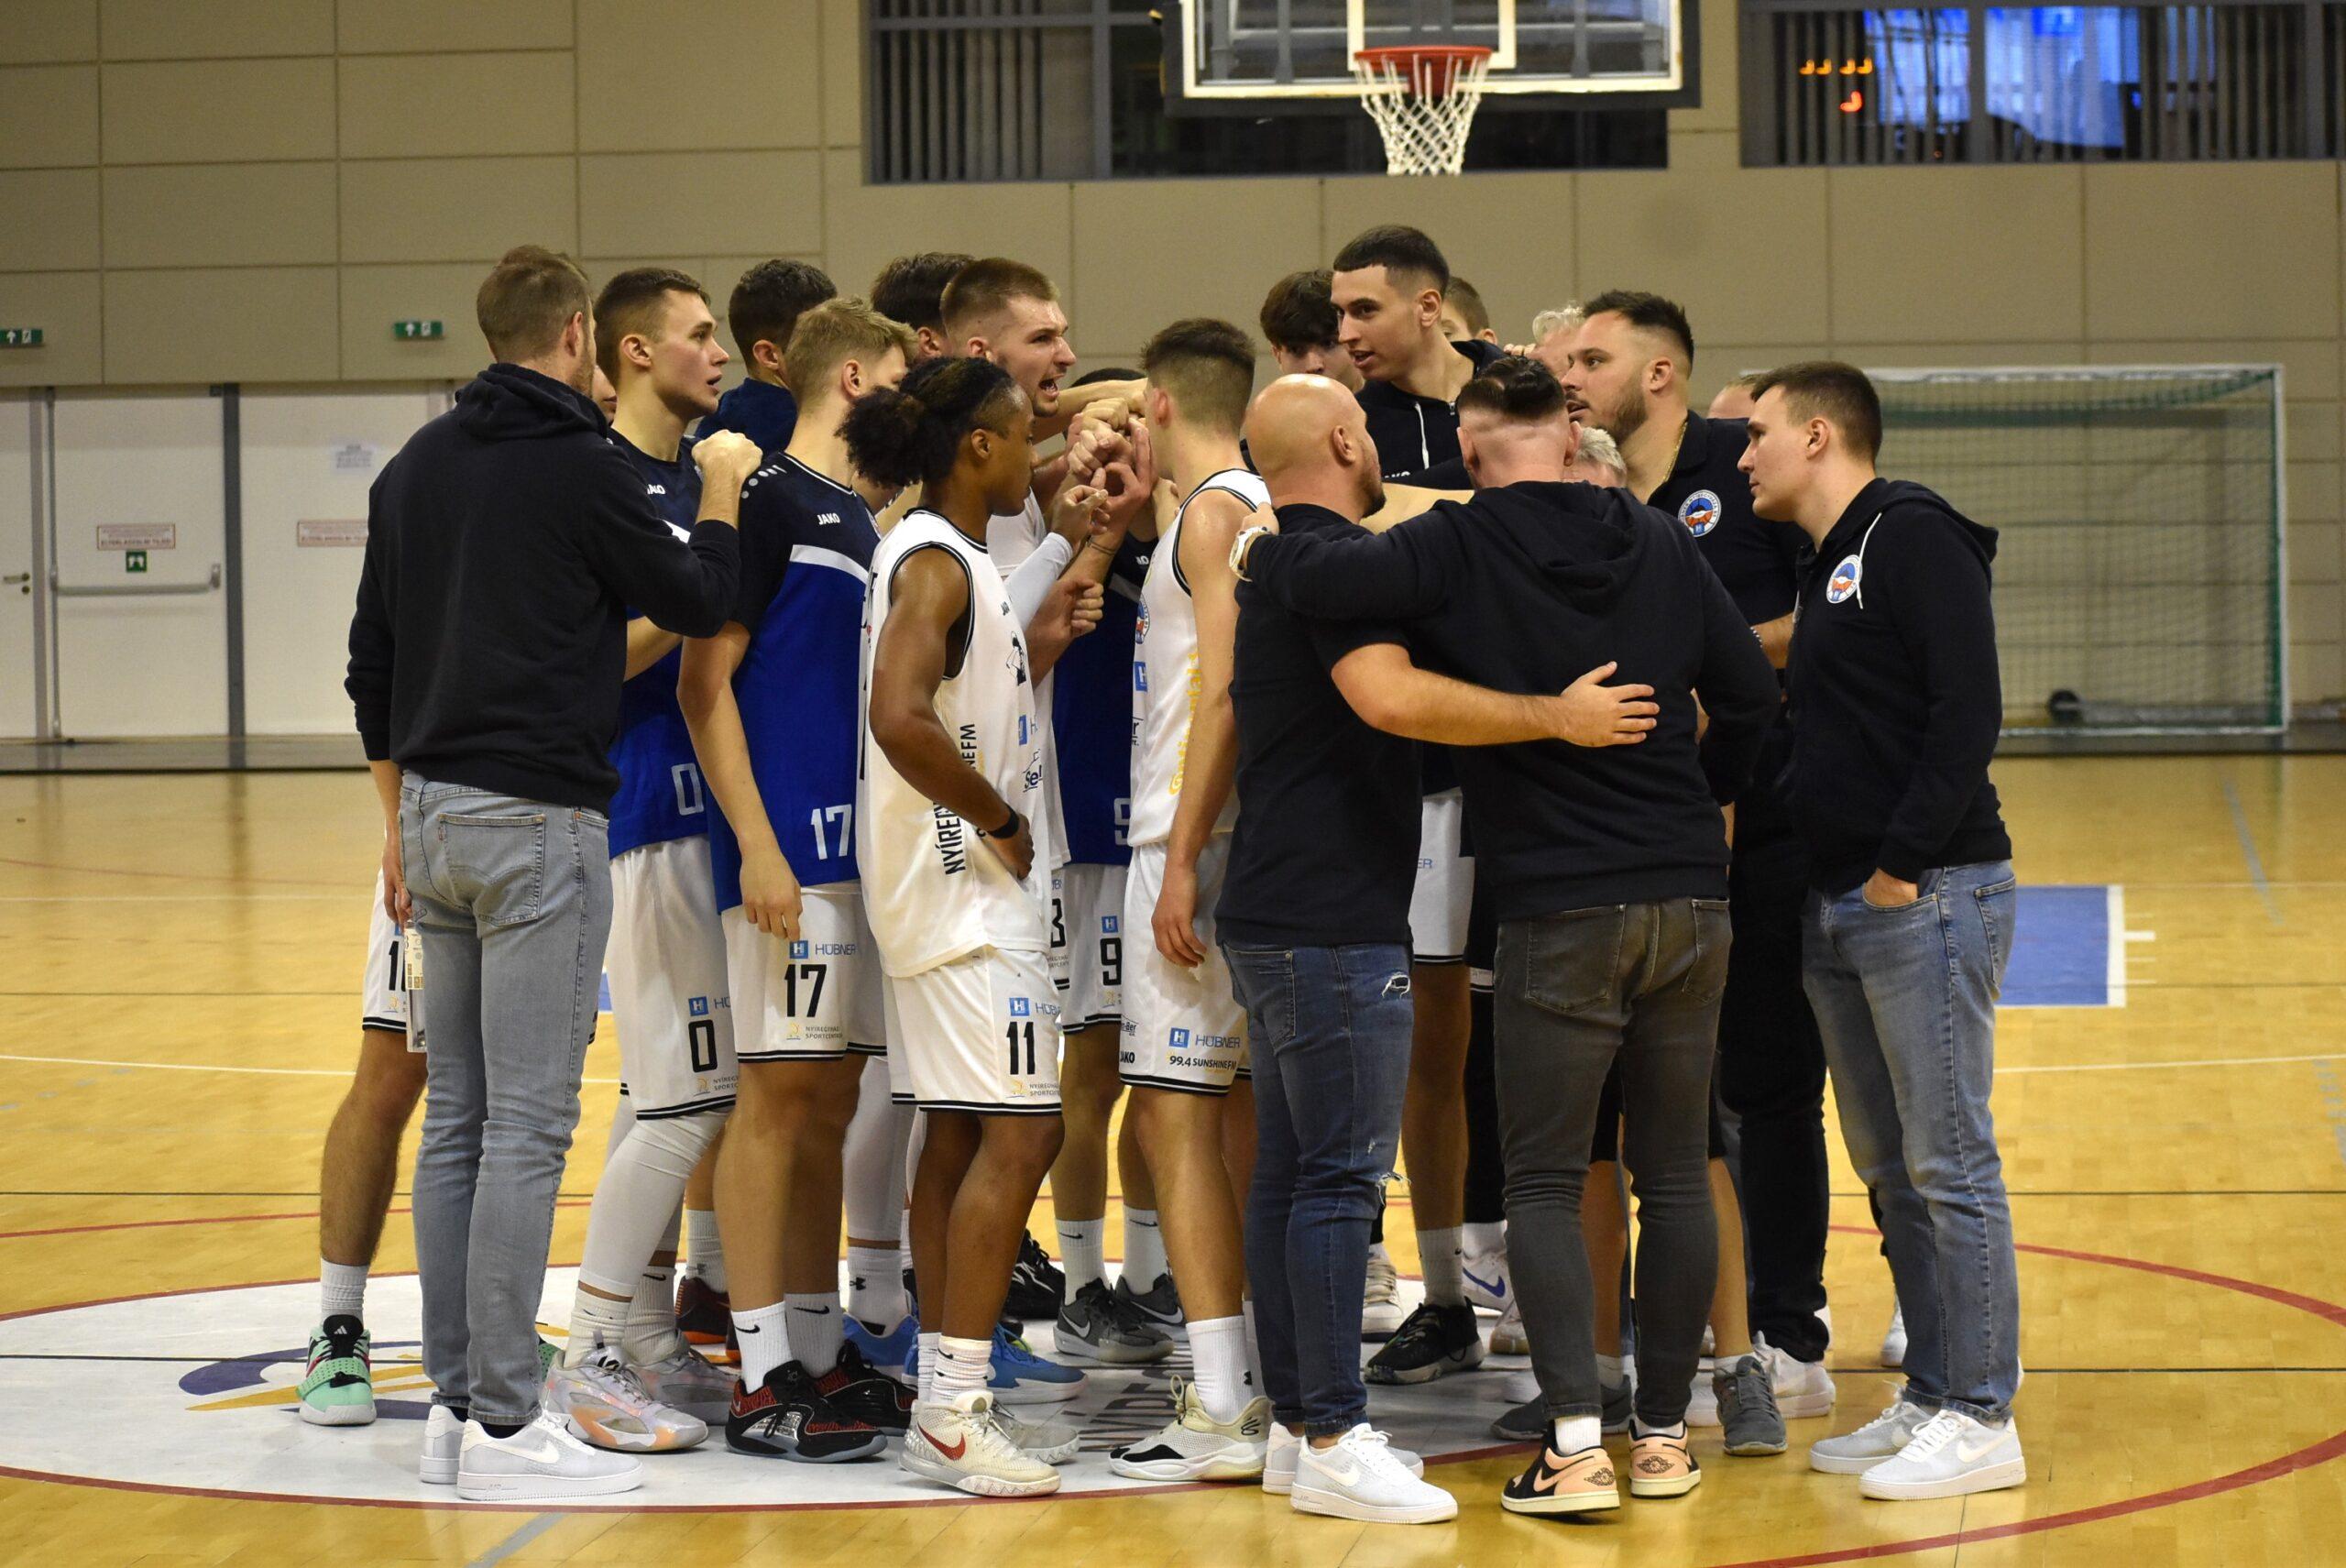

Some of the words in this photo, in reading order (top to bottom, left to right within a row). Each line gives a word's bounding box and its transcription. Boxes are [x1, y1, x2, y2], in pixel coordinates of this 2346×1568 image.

[817, 513, 840, 525] JAKO
[671, 762, 704, 816] 0
[811, 804, 852, 860] 17
[815, 943, 857, 956] HÜBNER
[1101, 938, 1122, 986] 9
[784, 963, 828, 1018] 17
[688, 1019, 718, 1073] 0
[1006, 1021, 1036, 1075] 11
[1168, 1055, 1191, 1067] 99.4
[1195, 1034, 1242, 1048] HÜBNER
